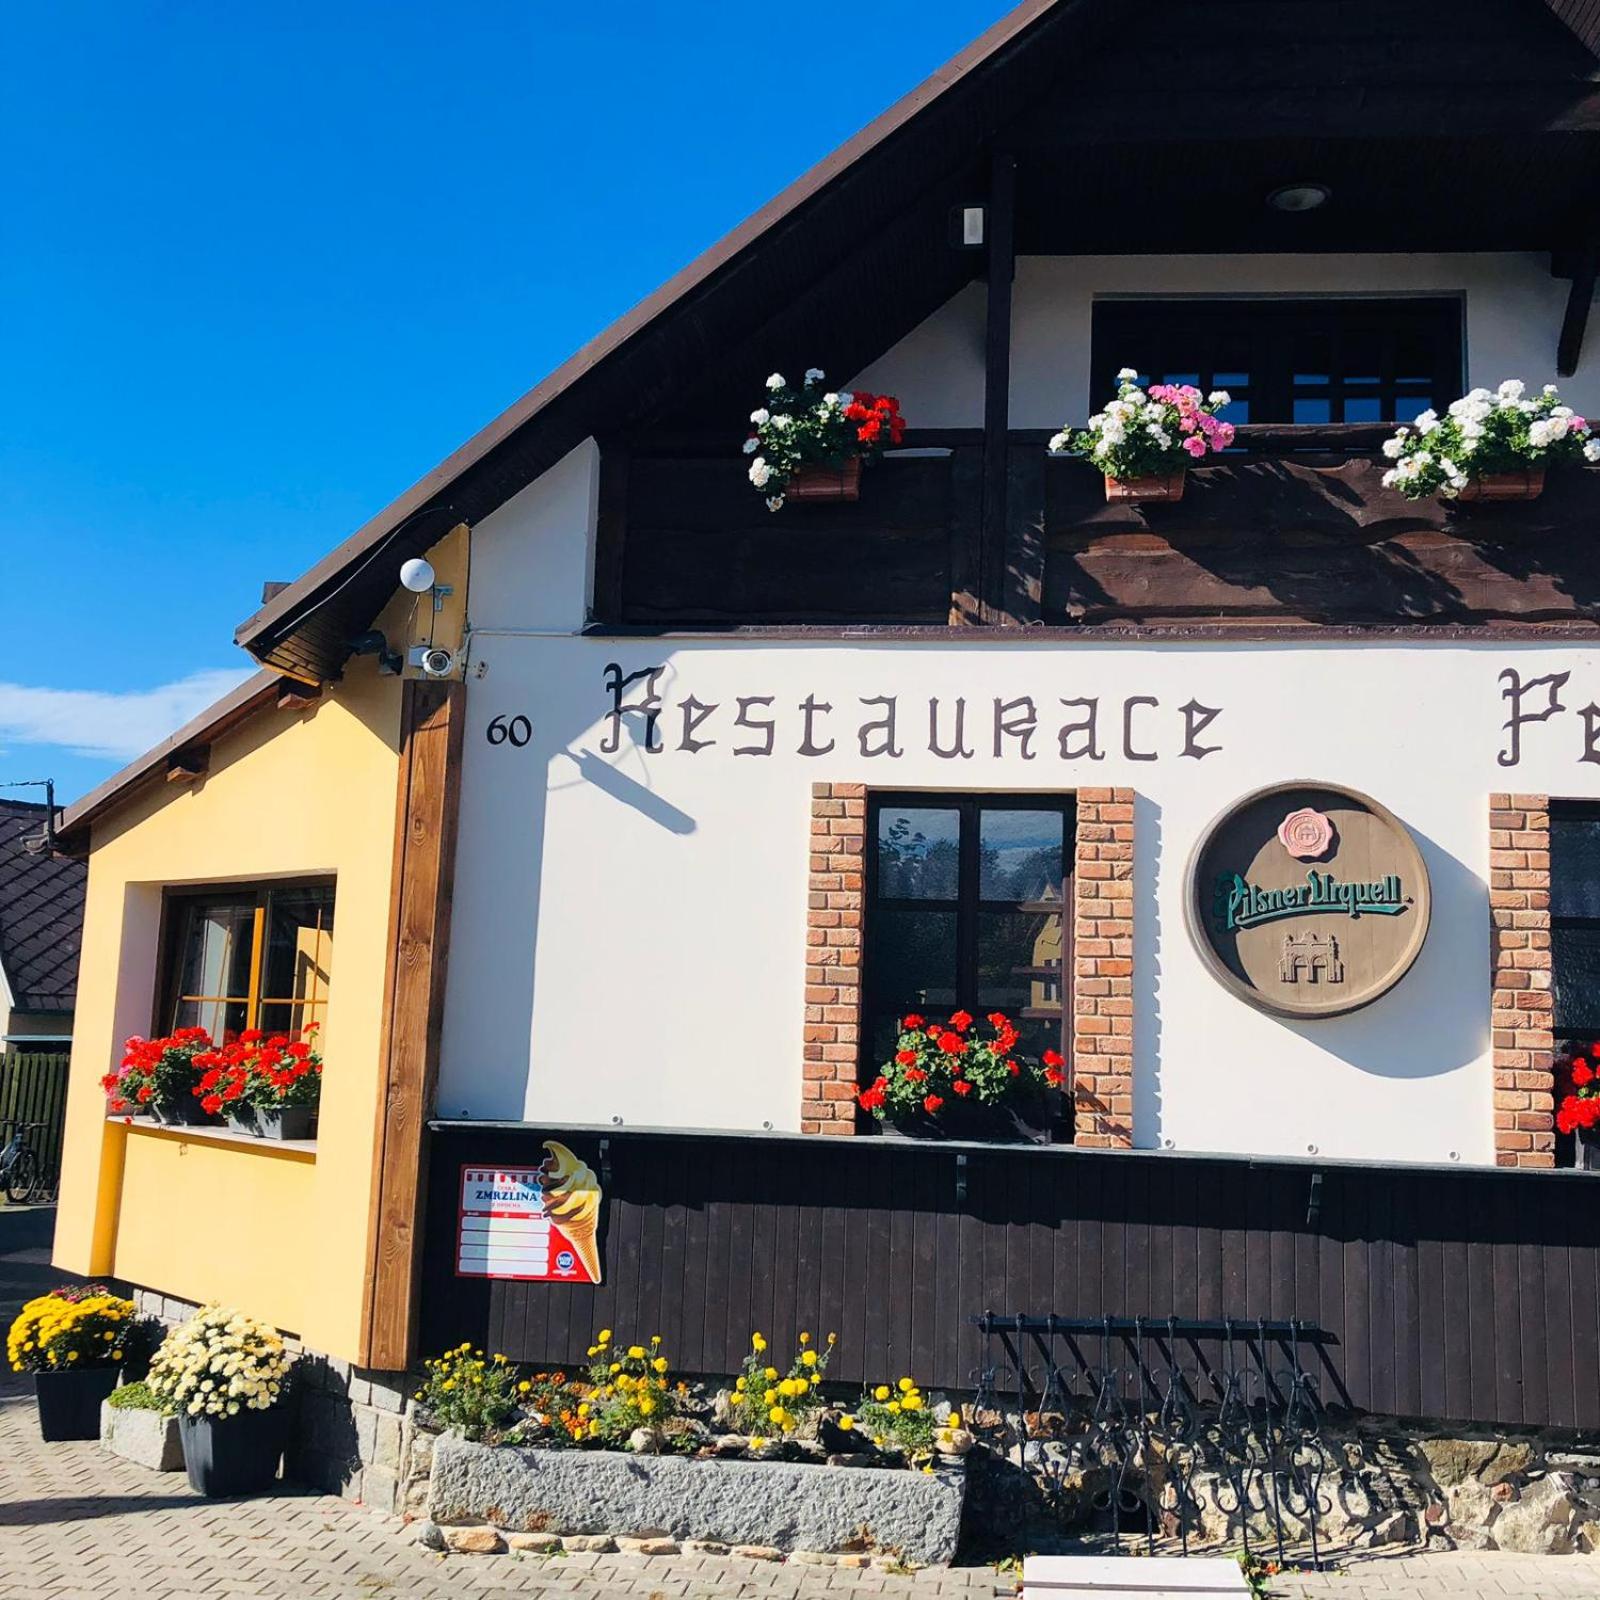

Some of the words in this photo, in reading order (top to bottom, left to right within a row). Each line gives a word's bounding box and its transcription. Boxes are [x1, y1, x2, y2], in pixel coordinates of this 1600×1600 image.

[486, 714, 532, 747] 60
[600, 663, 1223, 761] Restaurace
[1214, 869, 1311, 930] Pilsner
[475, 1190, 538, 1202] ZMRZLINA
